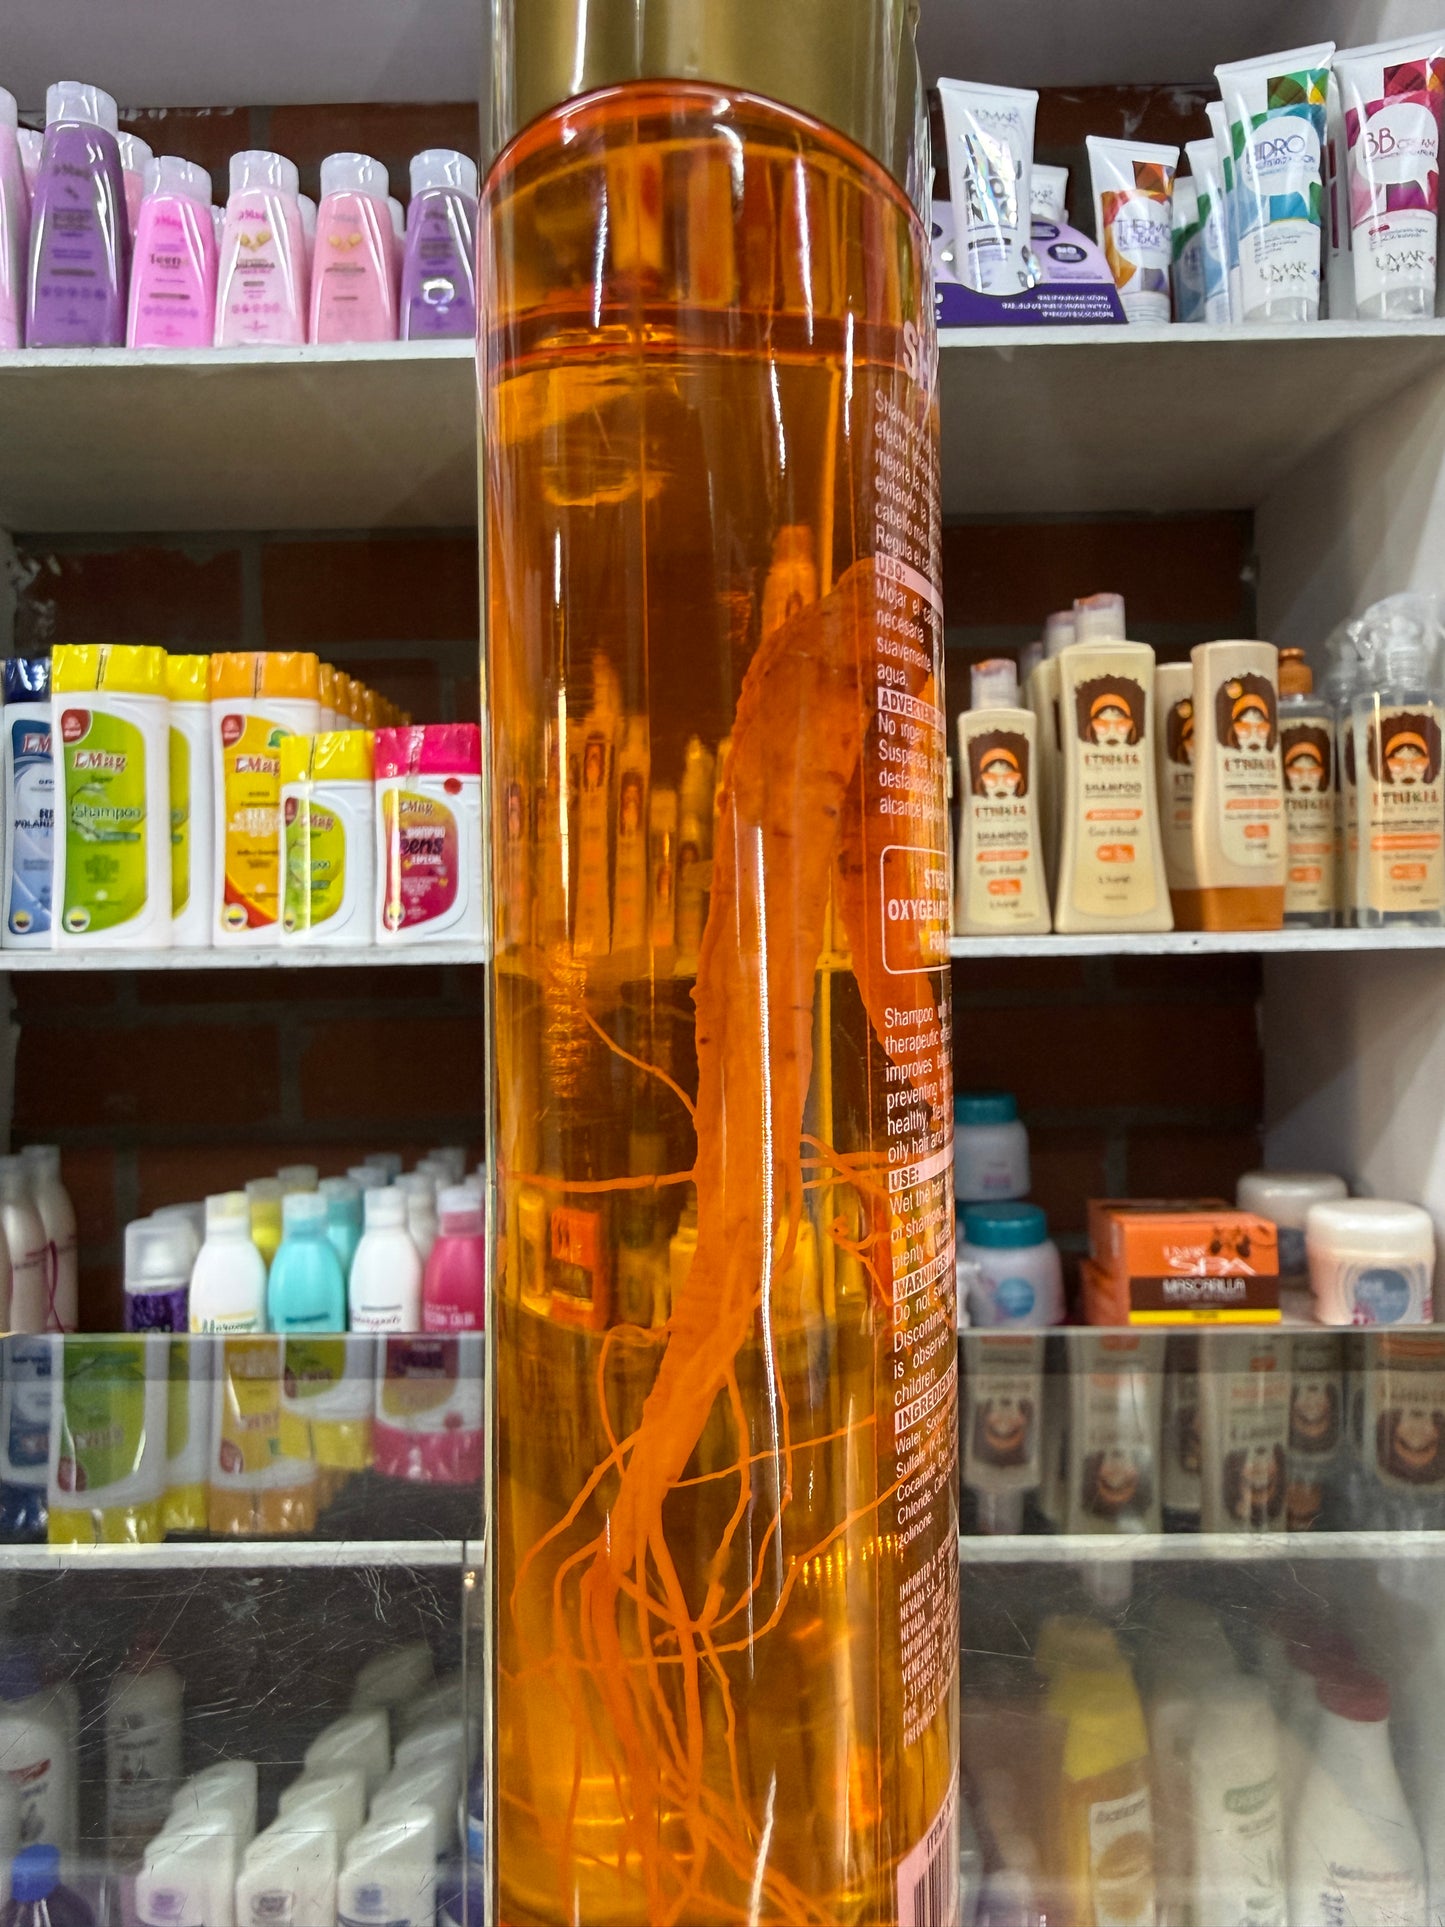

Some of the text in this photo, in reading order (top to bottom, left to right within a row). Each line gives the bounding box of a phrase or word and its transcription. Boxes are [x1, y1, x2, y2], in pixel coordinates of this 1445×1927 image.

[876, 523, 913, 561] Regula
[879, 554, 906, 582] USO:
[877, 578, 908, 610] Mojar
[877, 663, 909, 688] agua.
[878, 711, 897, 736] No
[884, 1007, 934, 1029] Shampoo
[885, 1057, 933, 1084] improves
[888, 1140, 909, 1165] oily
[911, 1135, 929, 1154] hair
[891, 1165, 919, 1191] USE:
[889, 1191, 913, 1216] Wet
[894, 1292, 931, 1326] Do not
[894, 1360, 905, 1380] is
